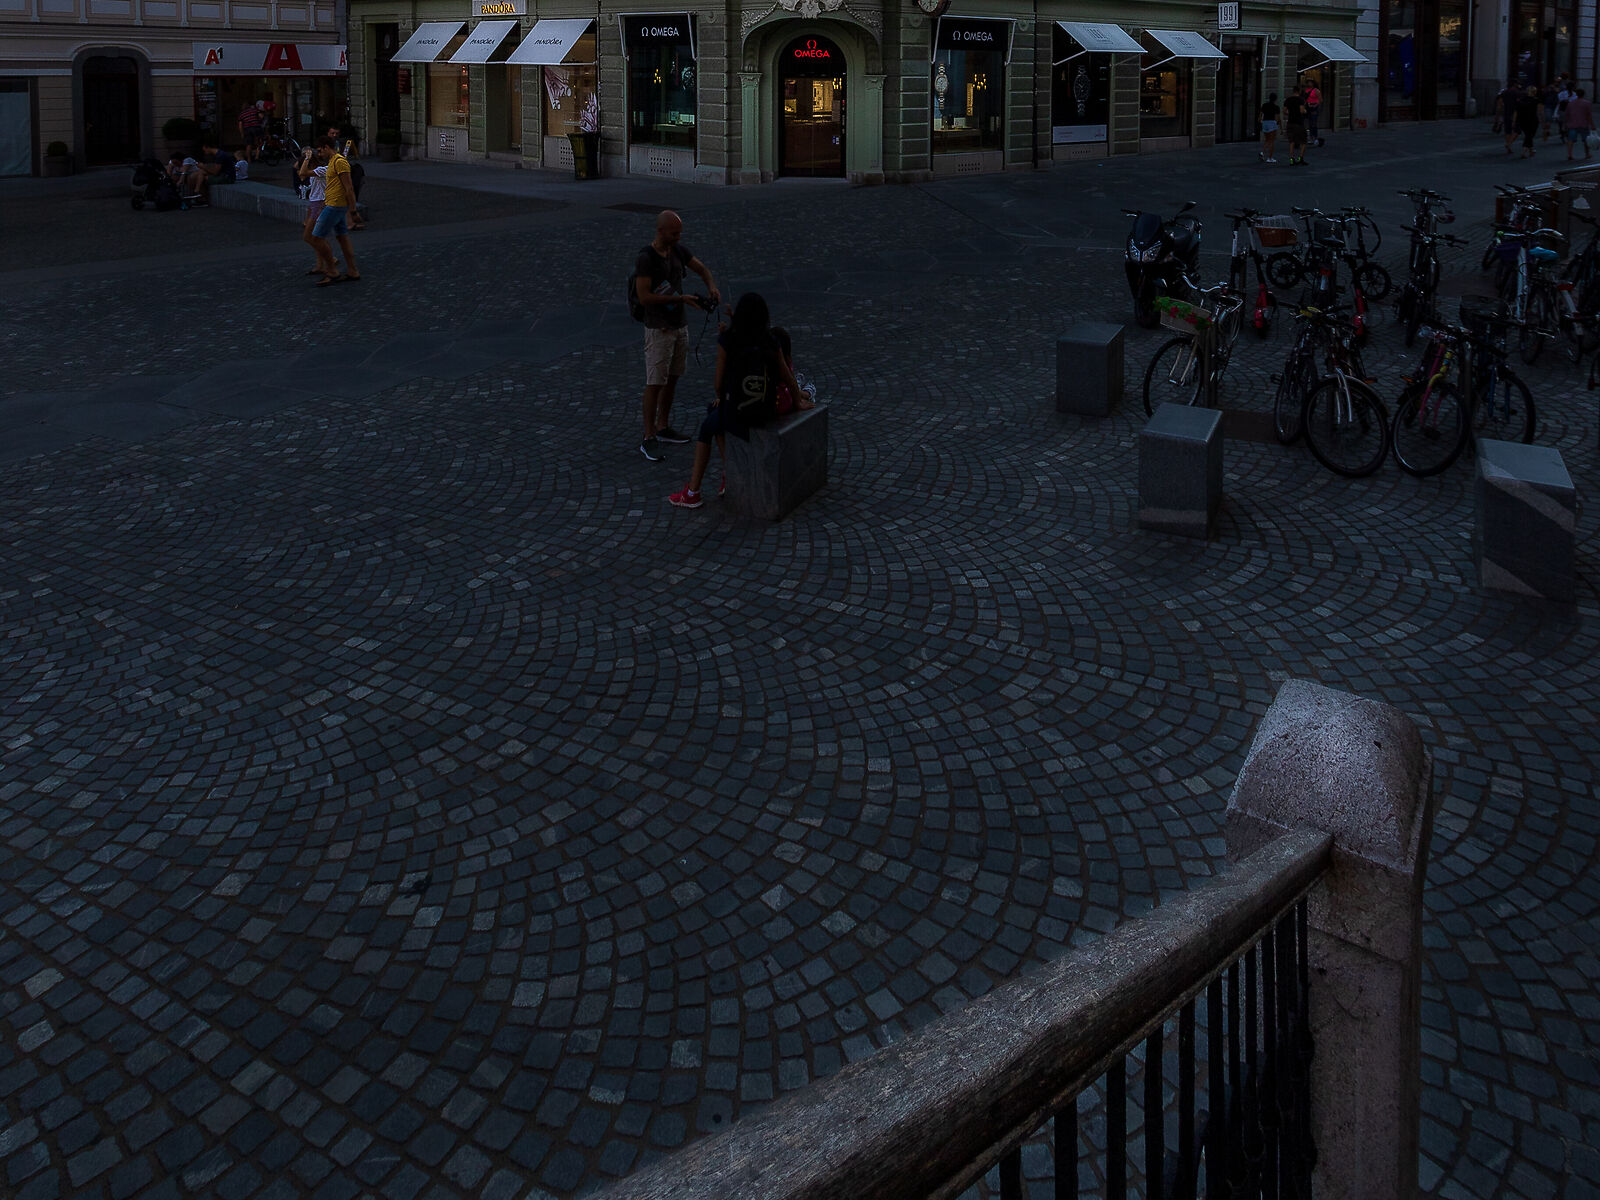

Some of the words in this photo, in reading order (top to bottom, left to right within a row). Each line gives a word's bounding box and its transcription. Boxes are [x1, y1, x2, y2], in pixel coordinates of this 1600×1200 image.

[1220, 5, 1237, 21] 1991
[650, 26, 680, 37] OMEGA
[963, 31, 994, 42] OMEGA
[204, 47, 224, 66] A1
[794, 49, 831, 58] OMEGA
